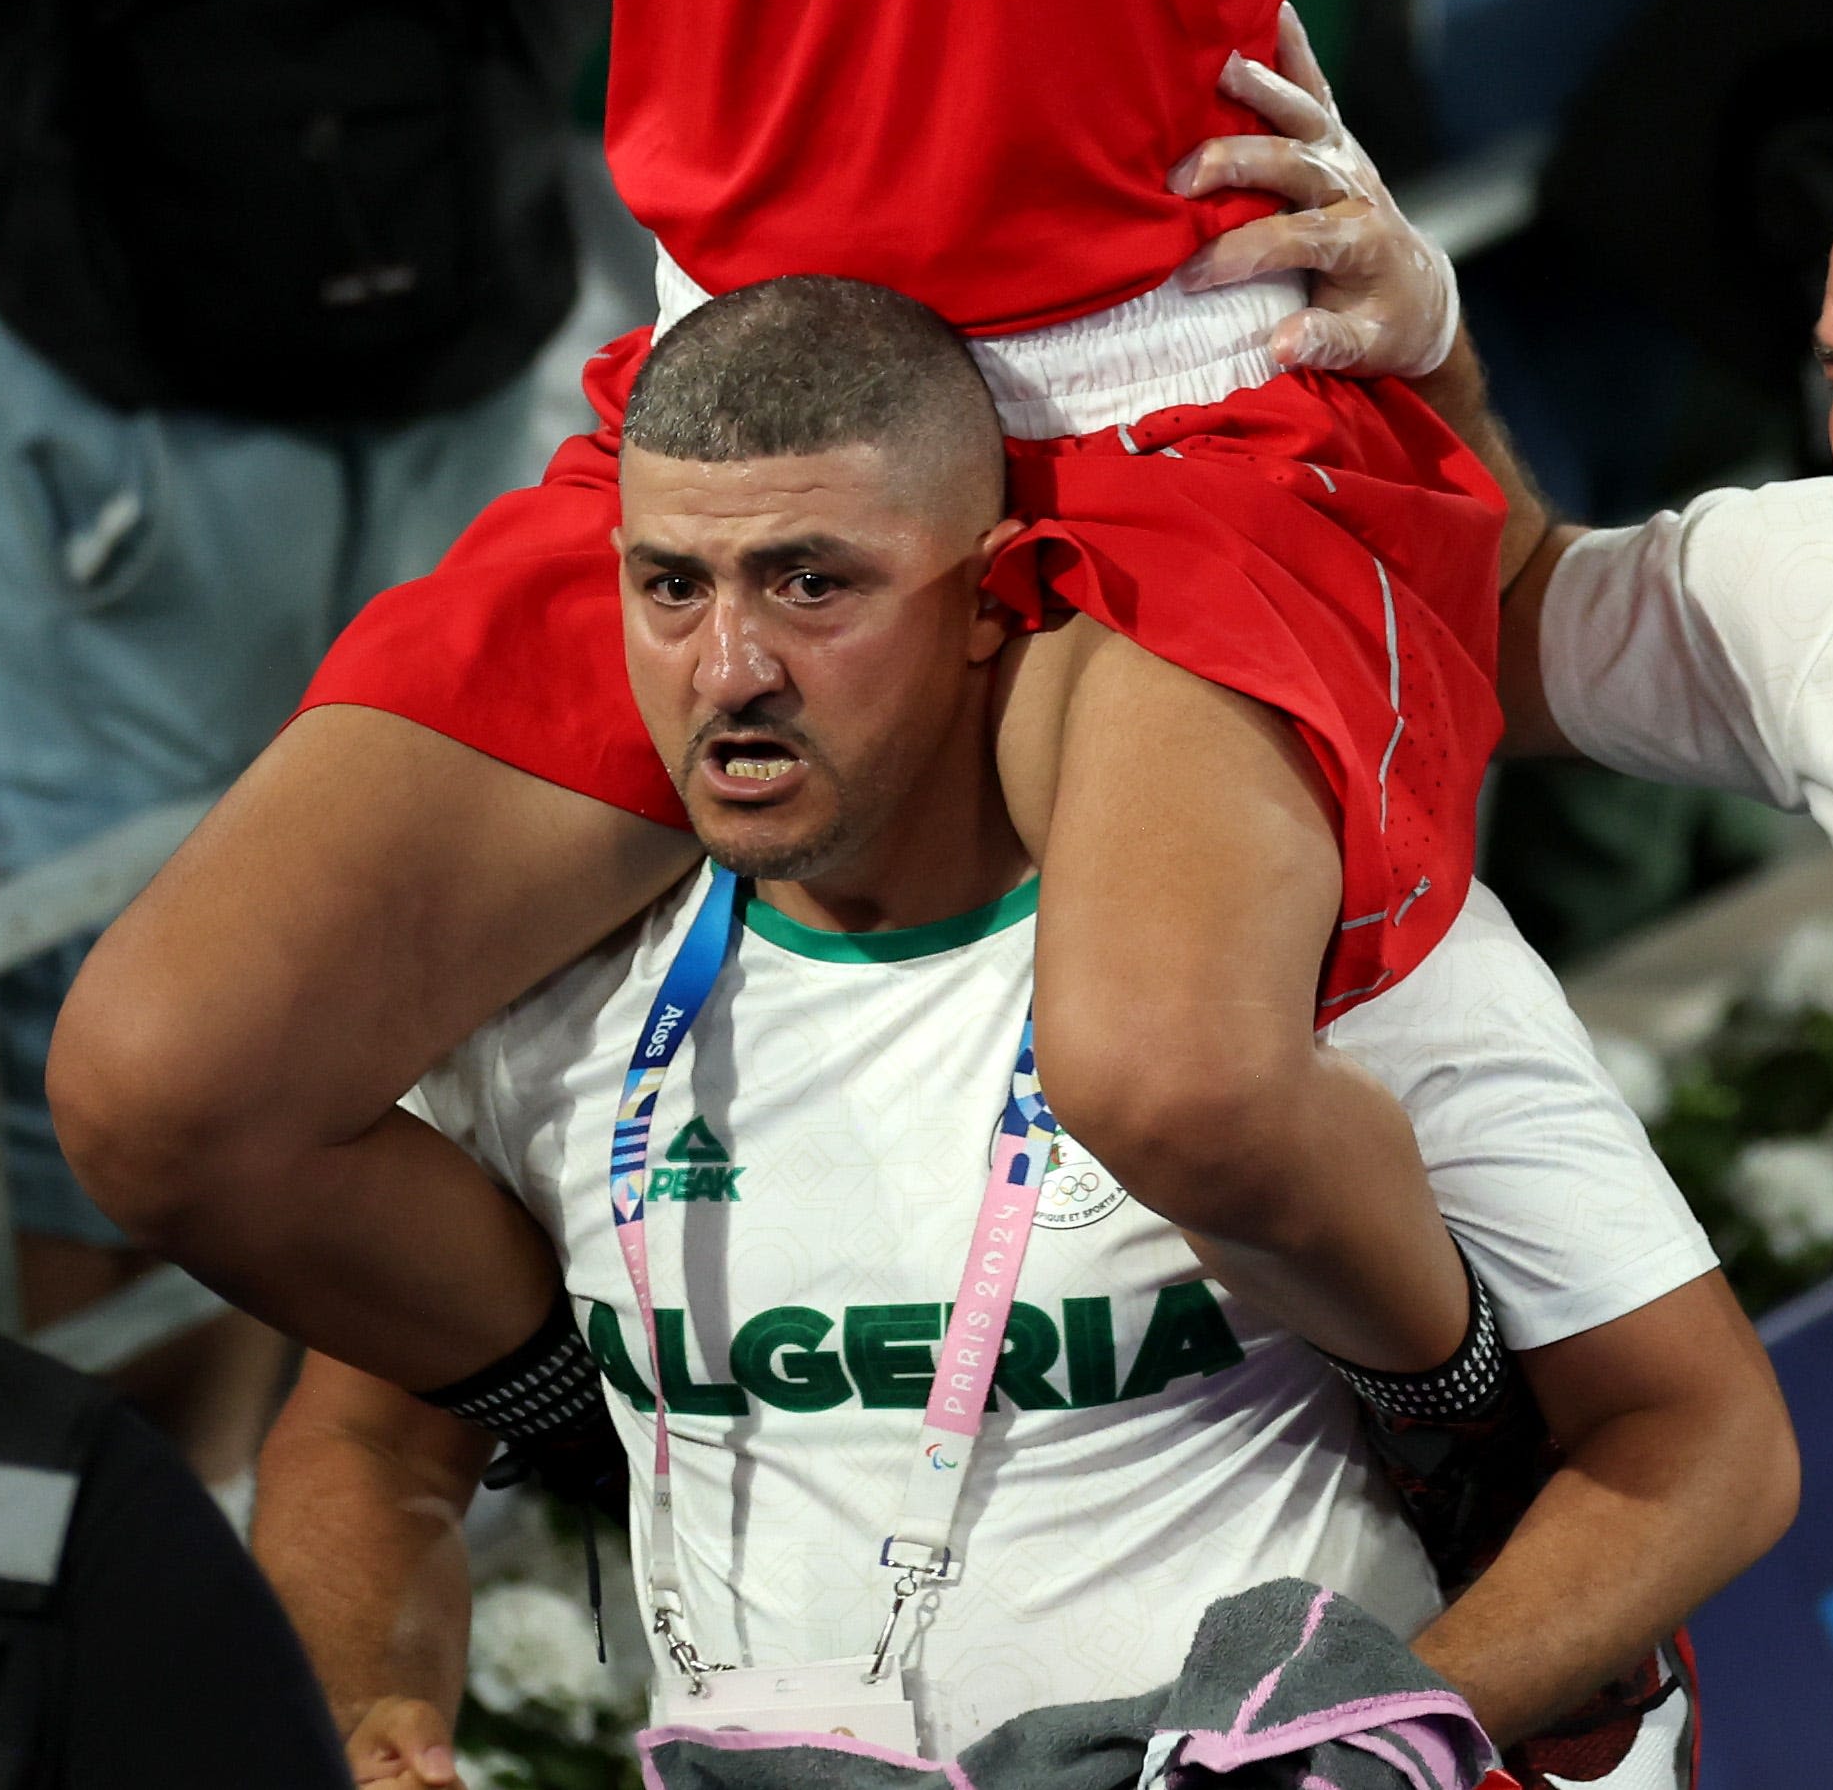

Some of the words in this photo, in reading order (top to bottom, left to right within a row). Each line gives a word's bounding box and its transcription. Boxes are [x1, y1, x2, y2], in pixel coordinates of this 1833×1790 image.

[645, 1003, 684, 1059] Atos
[645, 1167, 747, 1202] PEAK
[1069, 1213, 1080, 1222] ET
[1082, 1194, 1117, 1219] SPORTIF
[943, 1310, 992, 1416] PARIS
[974, 1203, 1021, 1299] 2024
[588, 1279, 1246, 1416] ALGERIA
